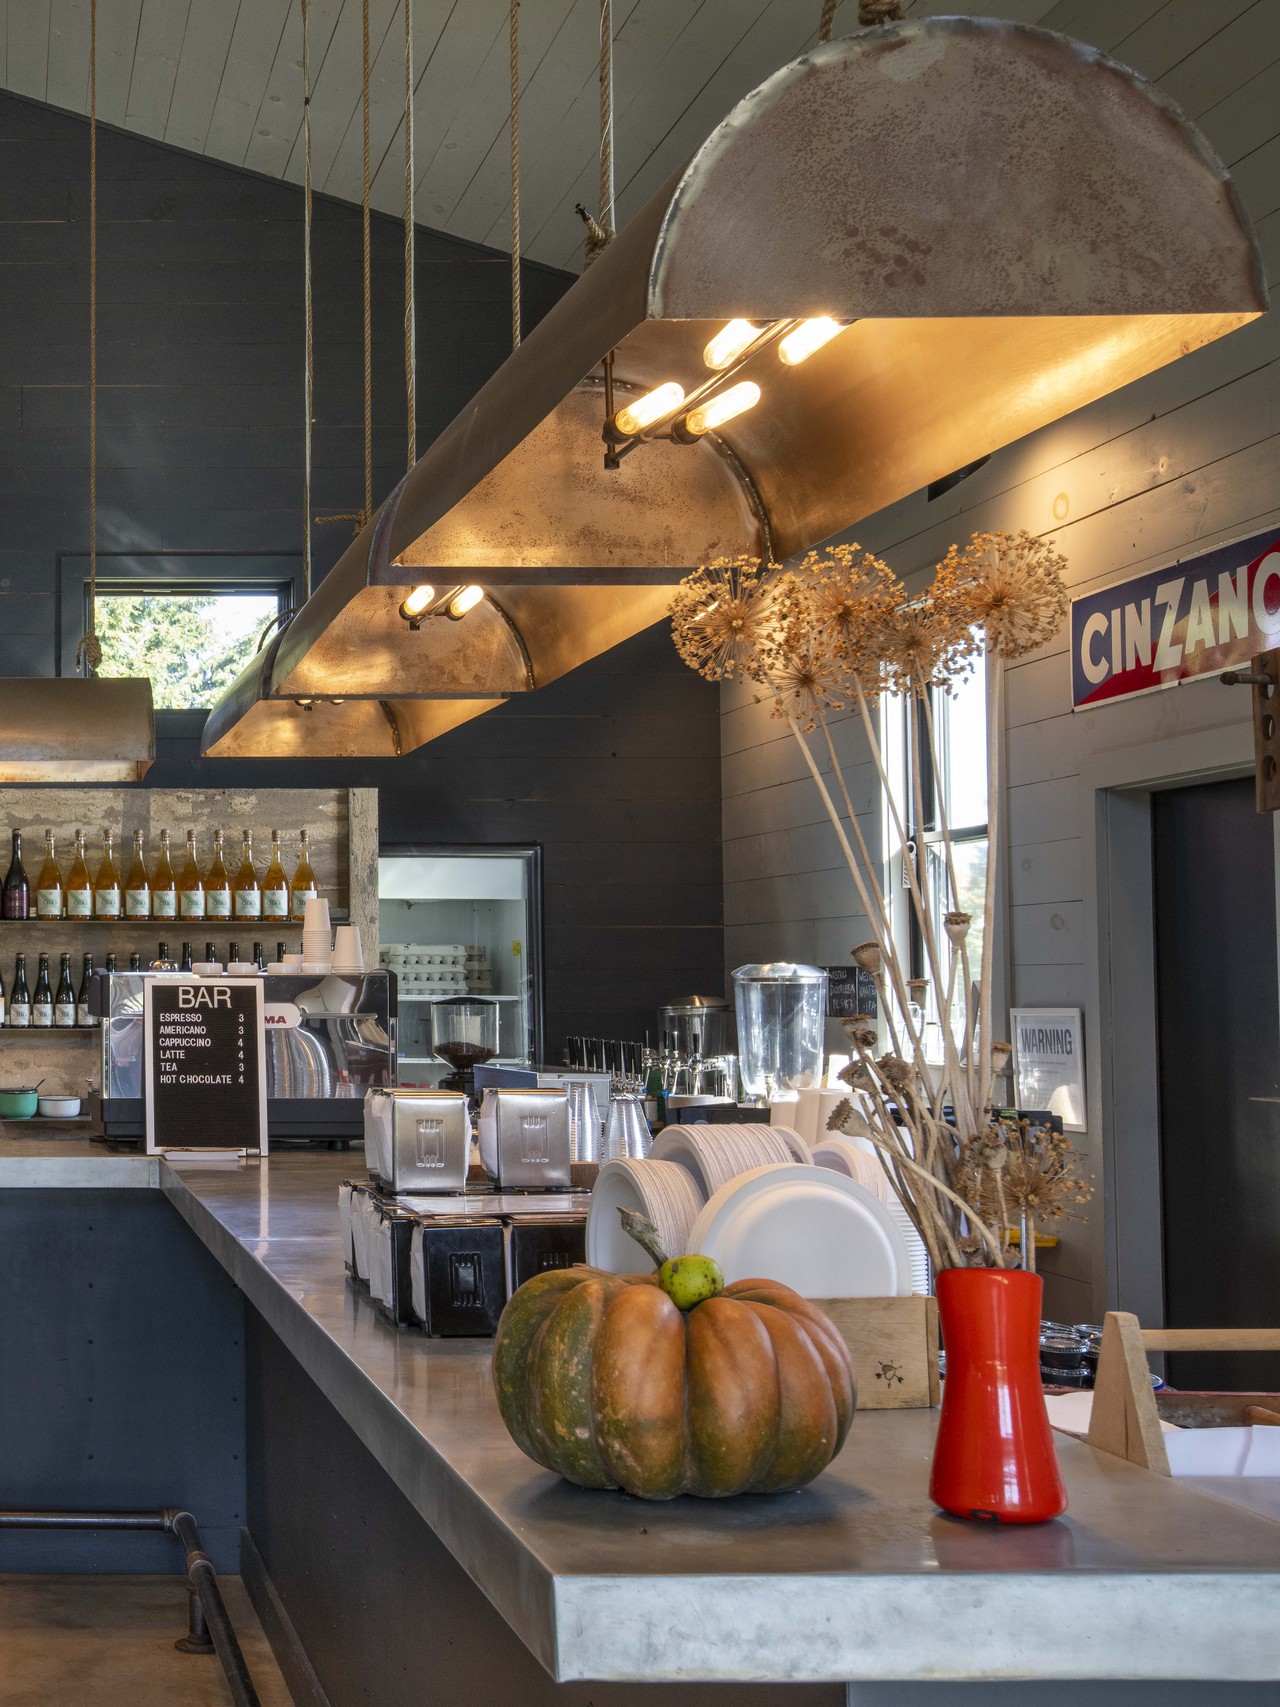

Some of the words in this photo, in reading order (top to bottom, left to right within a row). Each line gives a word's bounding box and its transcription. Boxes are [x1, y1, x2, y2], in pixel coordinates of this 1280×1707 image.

[178, 986, 232, 1008] BAR
[160, 1014, 202, 1022] ESPRESSO
[238, 1014, 244, 1022] 3
[160, 1026, 206, 1034] AMERICANO
[238, 1026, 244, 1034] 3
[159, 1038, 212, 1046] CAPPUCCINO
[238, 1038, 244, 1047] 4
[1021, 1028, 1072, 1056] WARNING
[160, 1050, 186, 1059] LATTE
[238, 1050, 244, 1060] 4
[161, 1062, 178, 1071] TEA
[238, 1062, 244, 1072] 3
[160, 1075, 176, 1084] HOT
[180, 1075, 232, 1084] CHOCOLATE
[238, 1076, 244, 1084] 4
